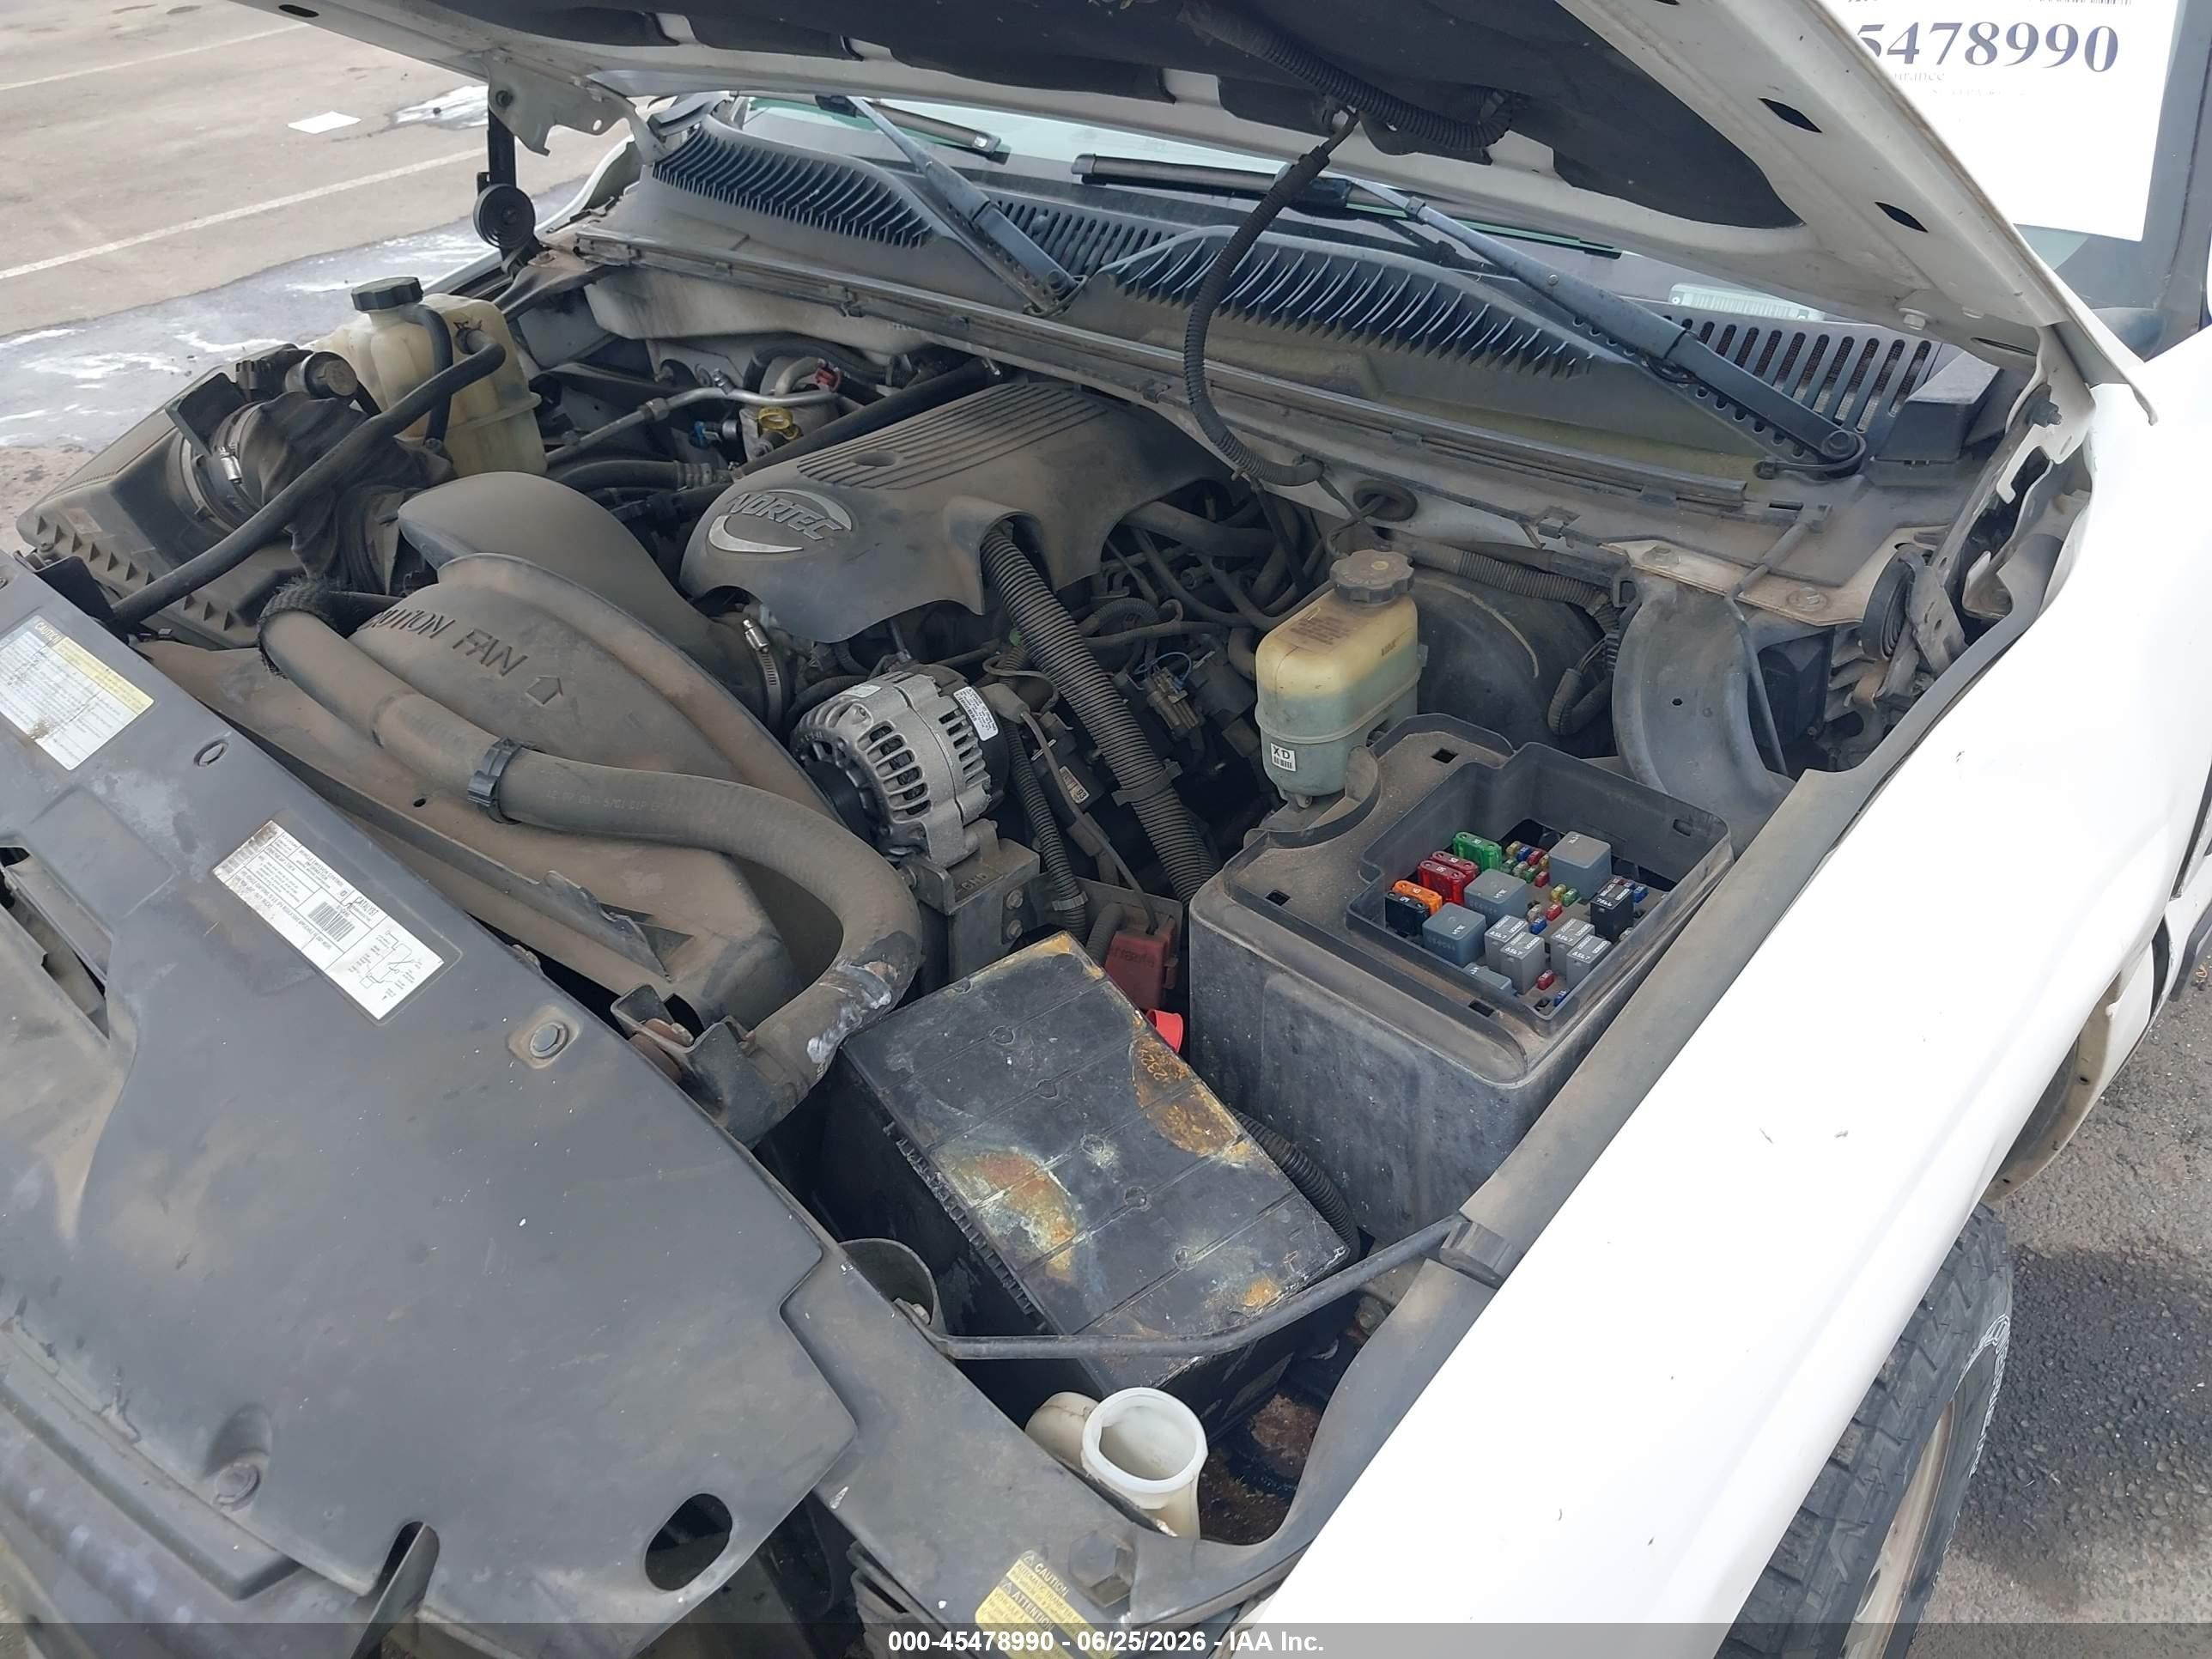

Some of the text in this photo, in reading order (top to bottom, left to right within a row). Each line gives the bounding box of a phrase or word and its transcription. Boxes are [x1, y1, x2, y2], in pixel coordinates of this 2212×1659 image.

[727, 492, 843, 541] VORTEC
[453, 629, 528, 677] FAN
[1273, 745, 1291, 759] XD
[355, 896, 380, 917] CATALYST
[1034, 1563, 1070, 1598] CAUTION
[1011, 1589, 1055, 1632] ATTENTION
